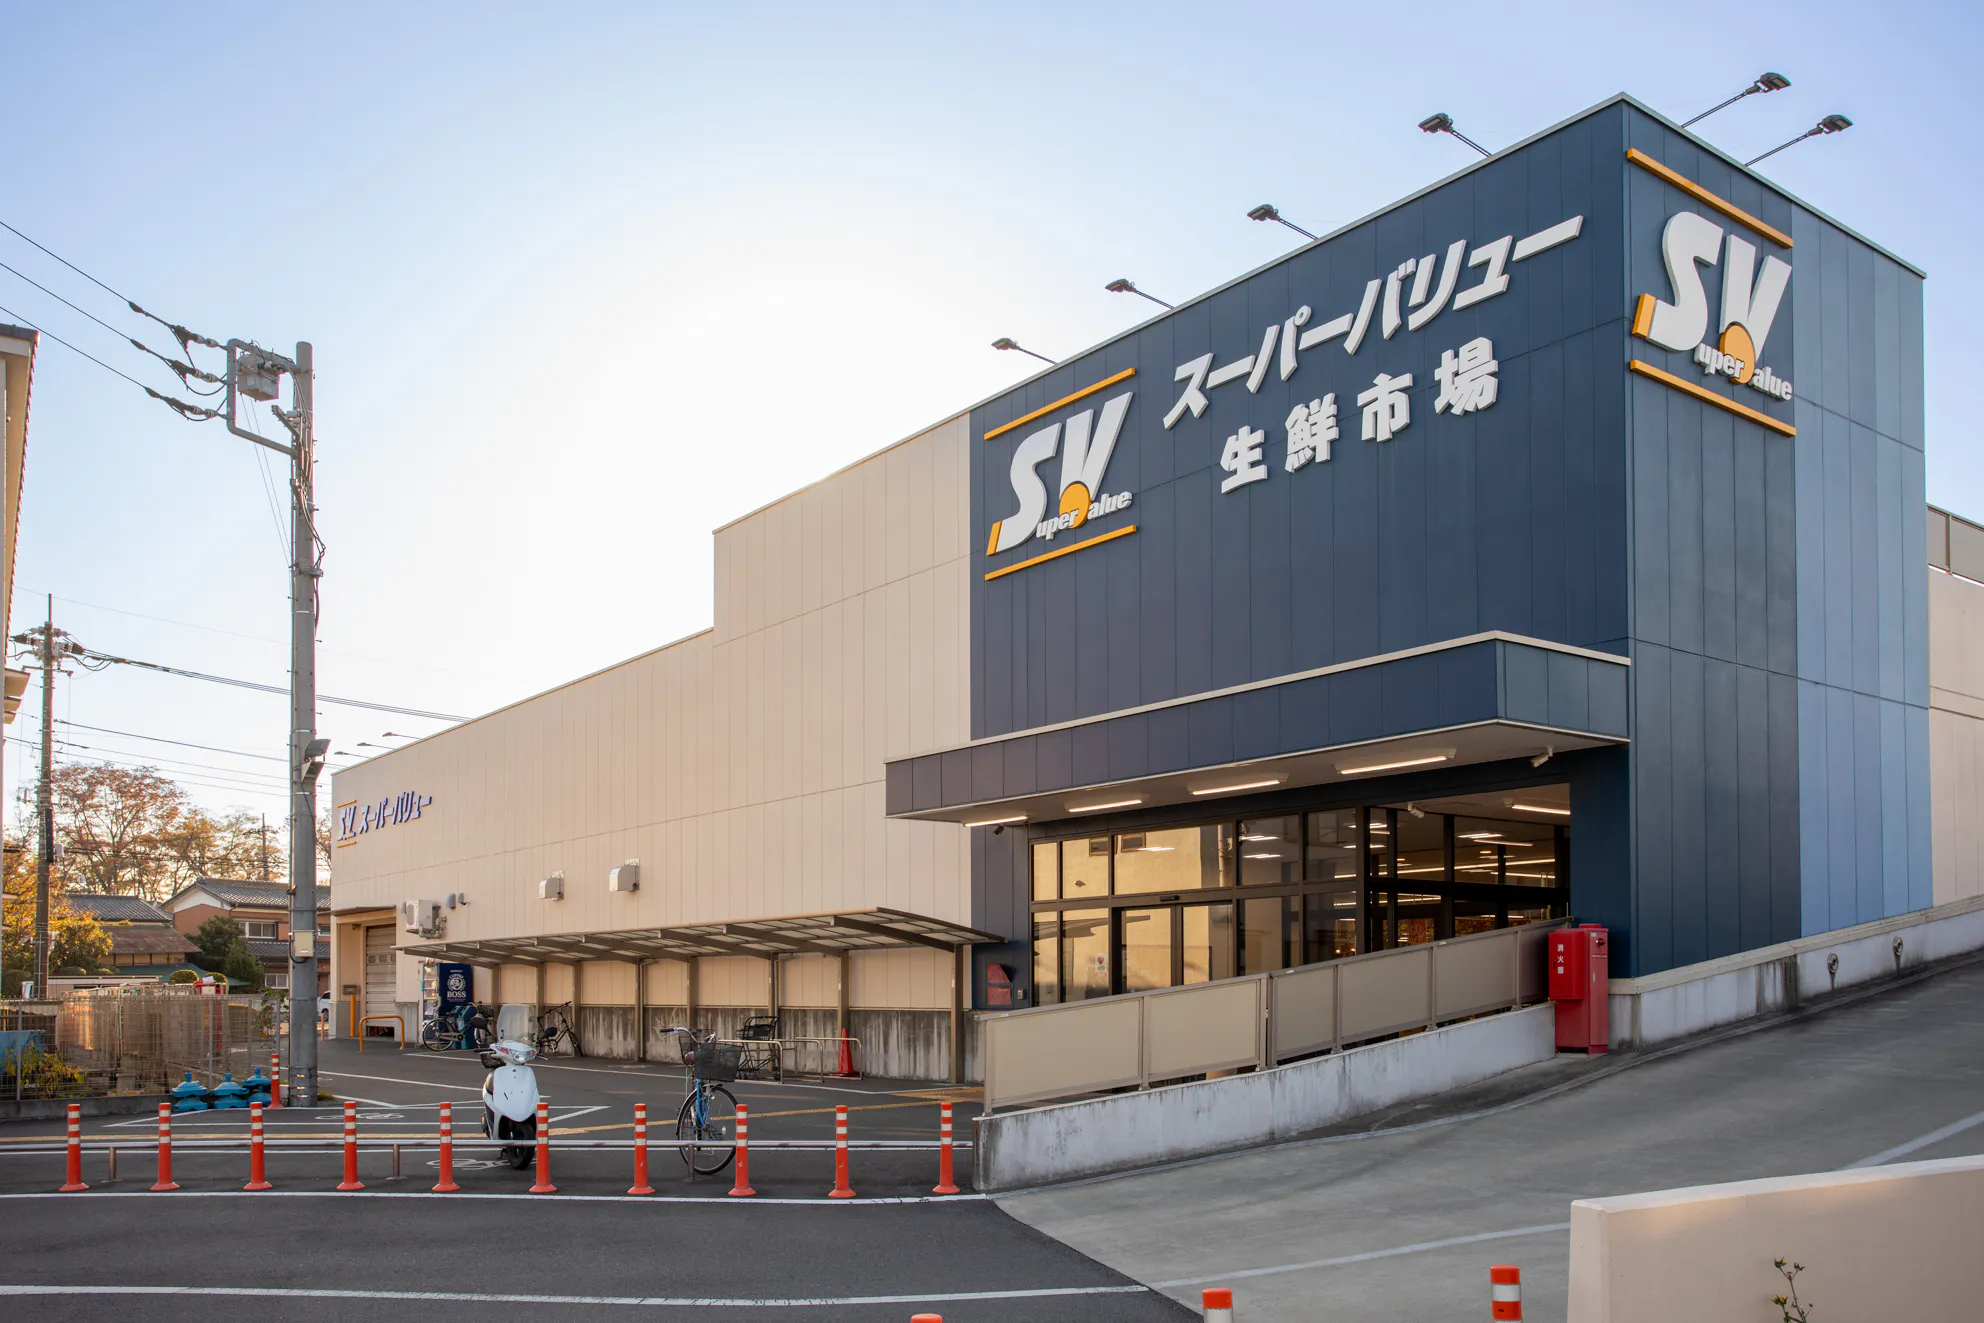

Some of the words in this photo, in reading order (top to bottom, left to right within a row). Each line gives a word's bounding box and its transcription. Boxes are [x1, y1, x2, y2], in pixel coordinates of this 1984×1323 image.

[1163, 215, 1583, 430] スーパーバリュー
[1220, 336, 1499, 495] 生鮮市場
[359, 791, 433, 834] スーパーバリュー
[447, 990, 467, 998] BOSS
